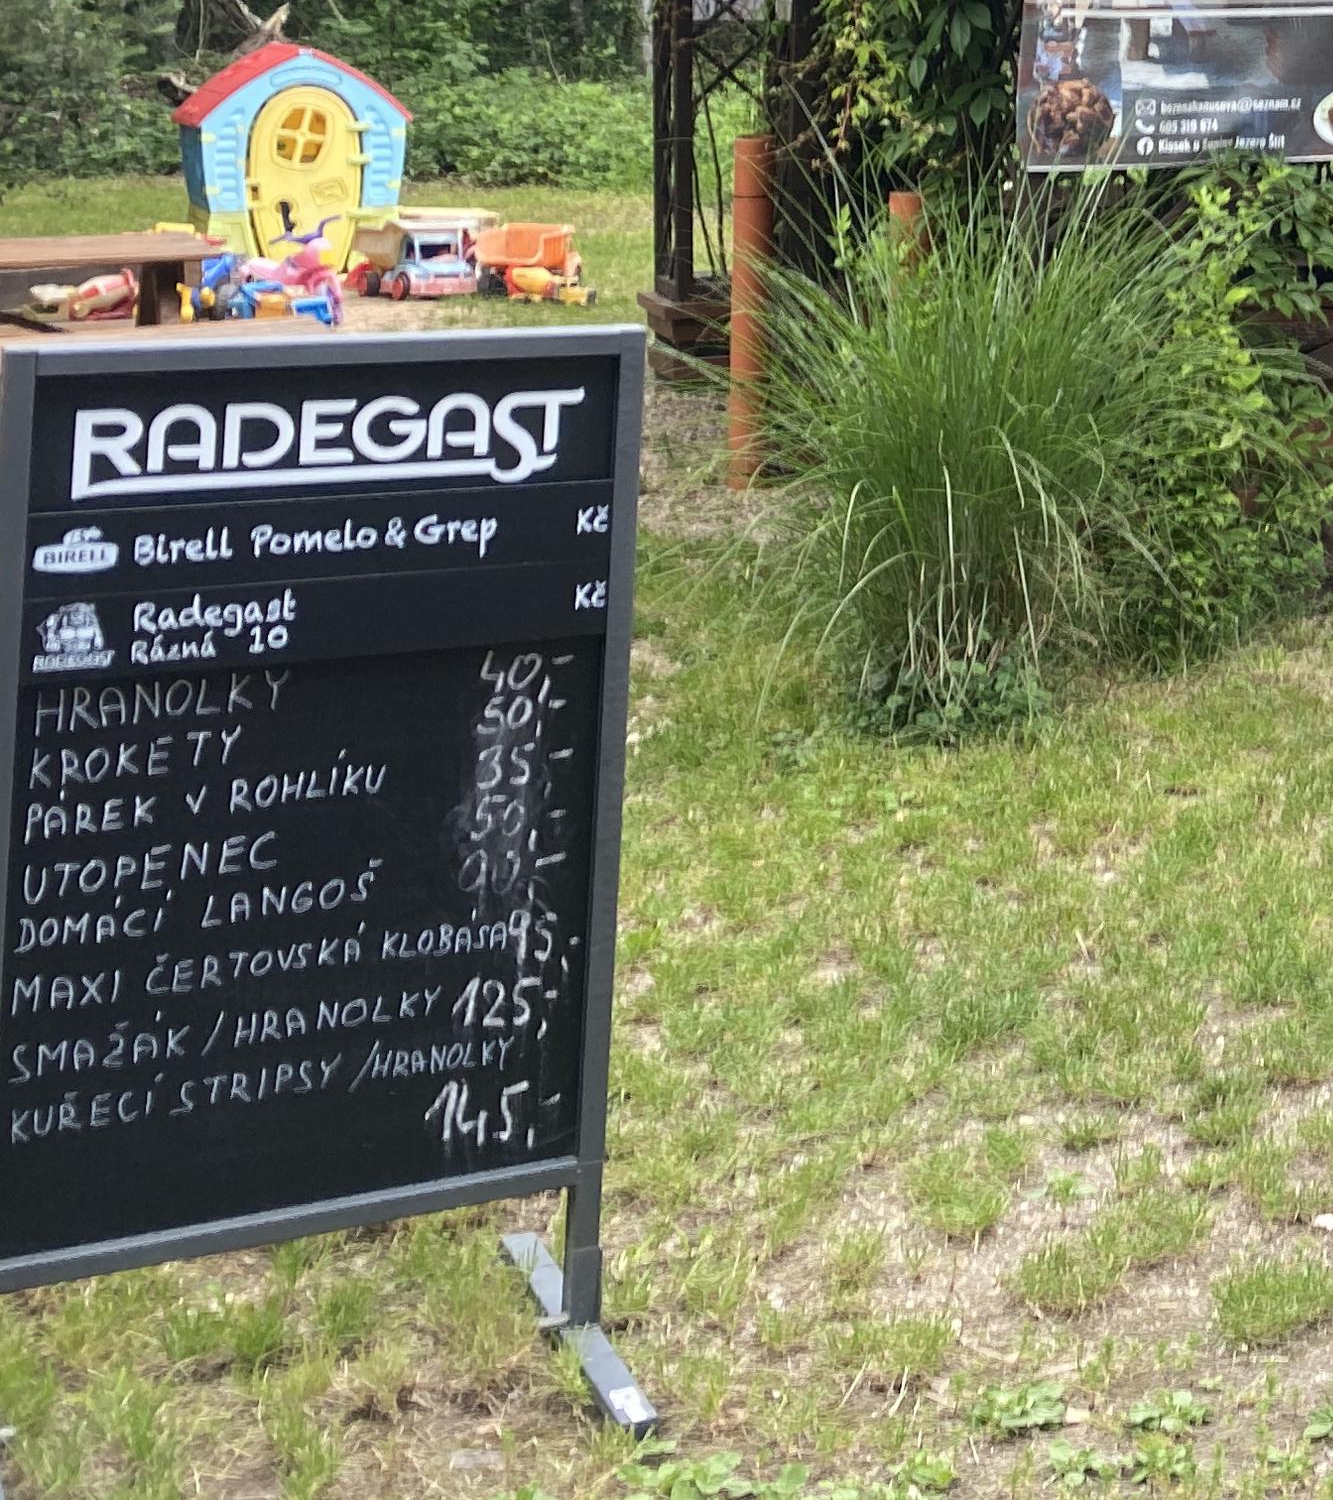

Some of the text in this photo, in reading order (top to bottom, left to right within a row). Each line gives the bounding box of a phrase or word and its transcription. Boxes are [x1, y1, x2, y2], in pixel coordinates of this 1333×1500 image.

[1158, 136, 1191, 155] Kiosek
[70, 386, 586, 500] RADEGAST
[43, 548, 106, 566] BIRELL
[133, 503, 610, 567] Birell Pomelo & Grep Kč
[133, 579, 608, 638] Radegast Kč
[130, 624, 289, 666] Rázná 10
[34, 668, 291, 738] HRANOLKY
[28, 723, 243, 790] KROKETY
[23, 788, 157, 845] PÁREK
[229, 748, 388, 815] ROHLÍKU
[23, 830, 279, 905] UTOPENEC
[13, 889, 173, 955] DOMÁCÍ
[201, 858, 385, 929] LANGOŠ
[11, 969, 121, 1017] MAXI
[145, 920, 367, 995] ČERTOVSKÁ
[381, 906, 507, 960] KLOBÁSA
[11, 1071, 165, 1146] KUŘECÍ
